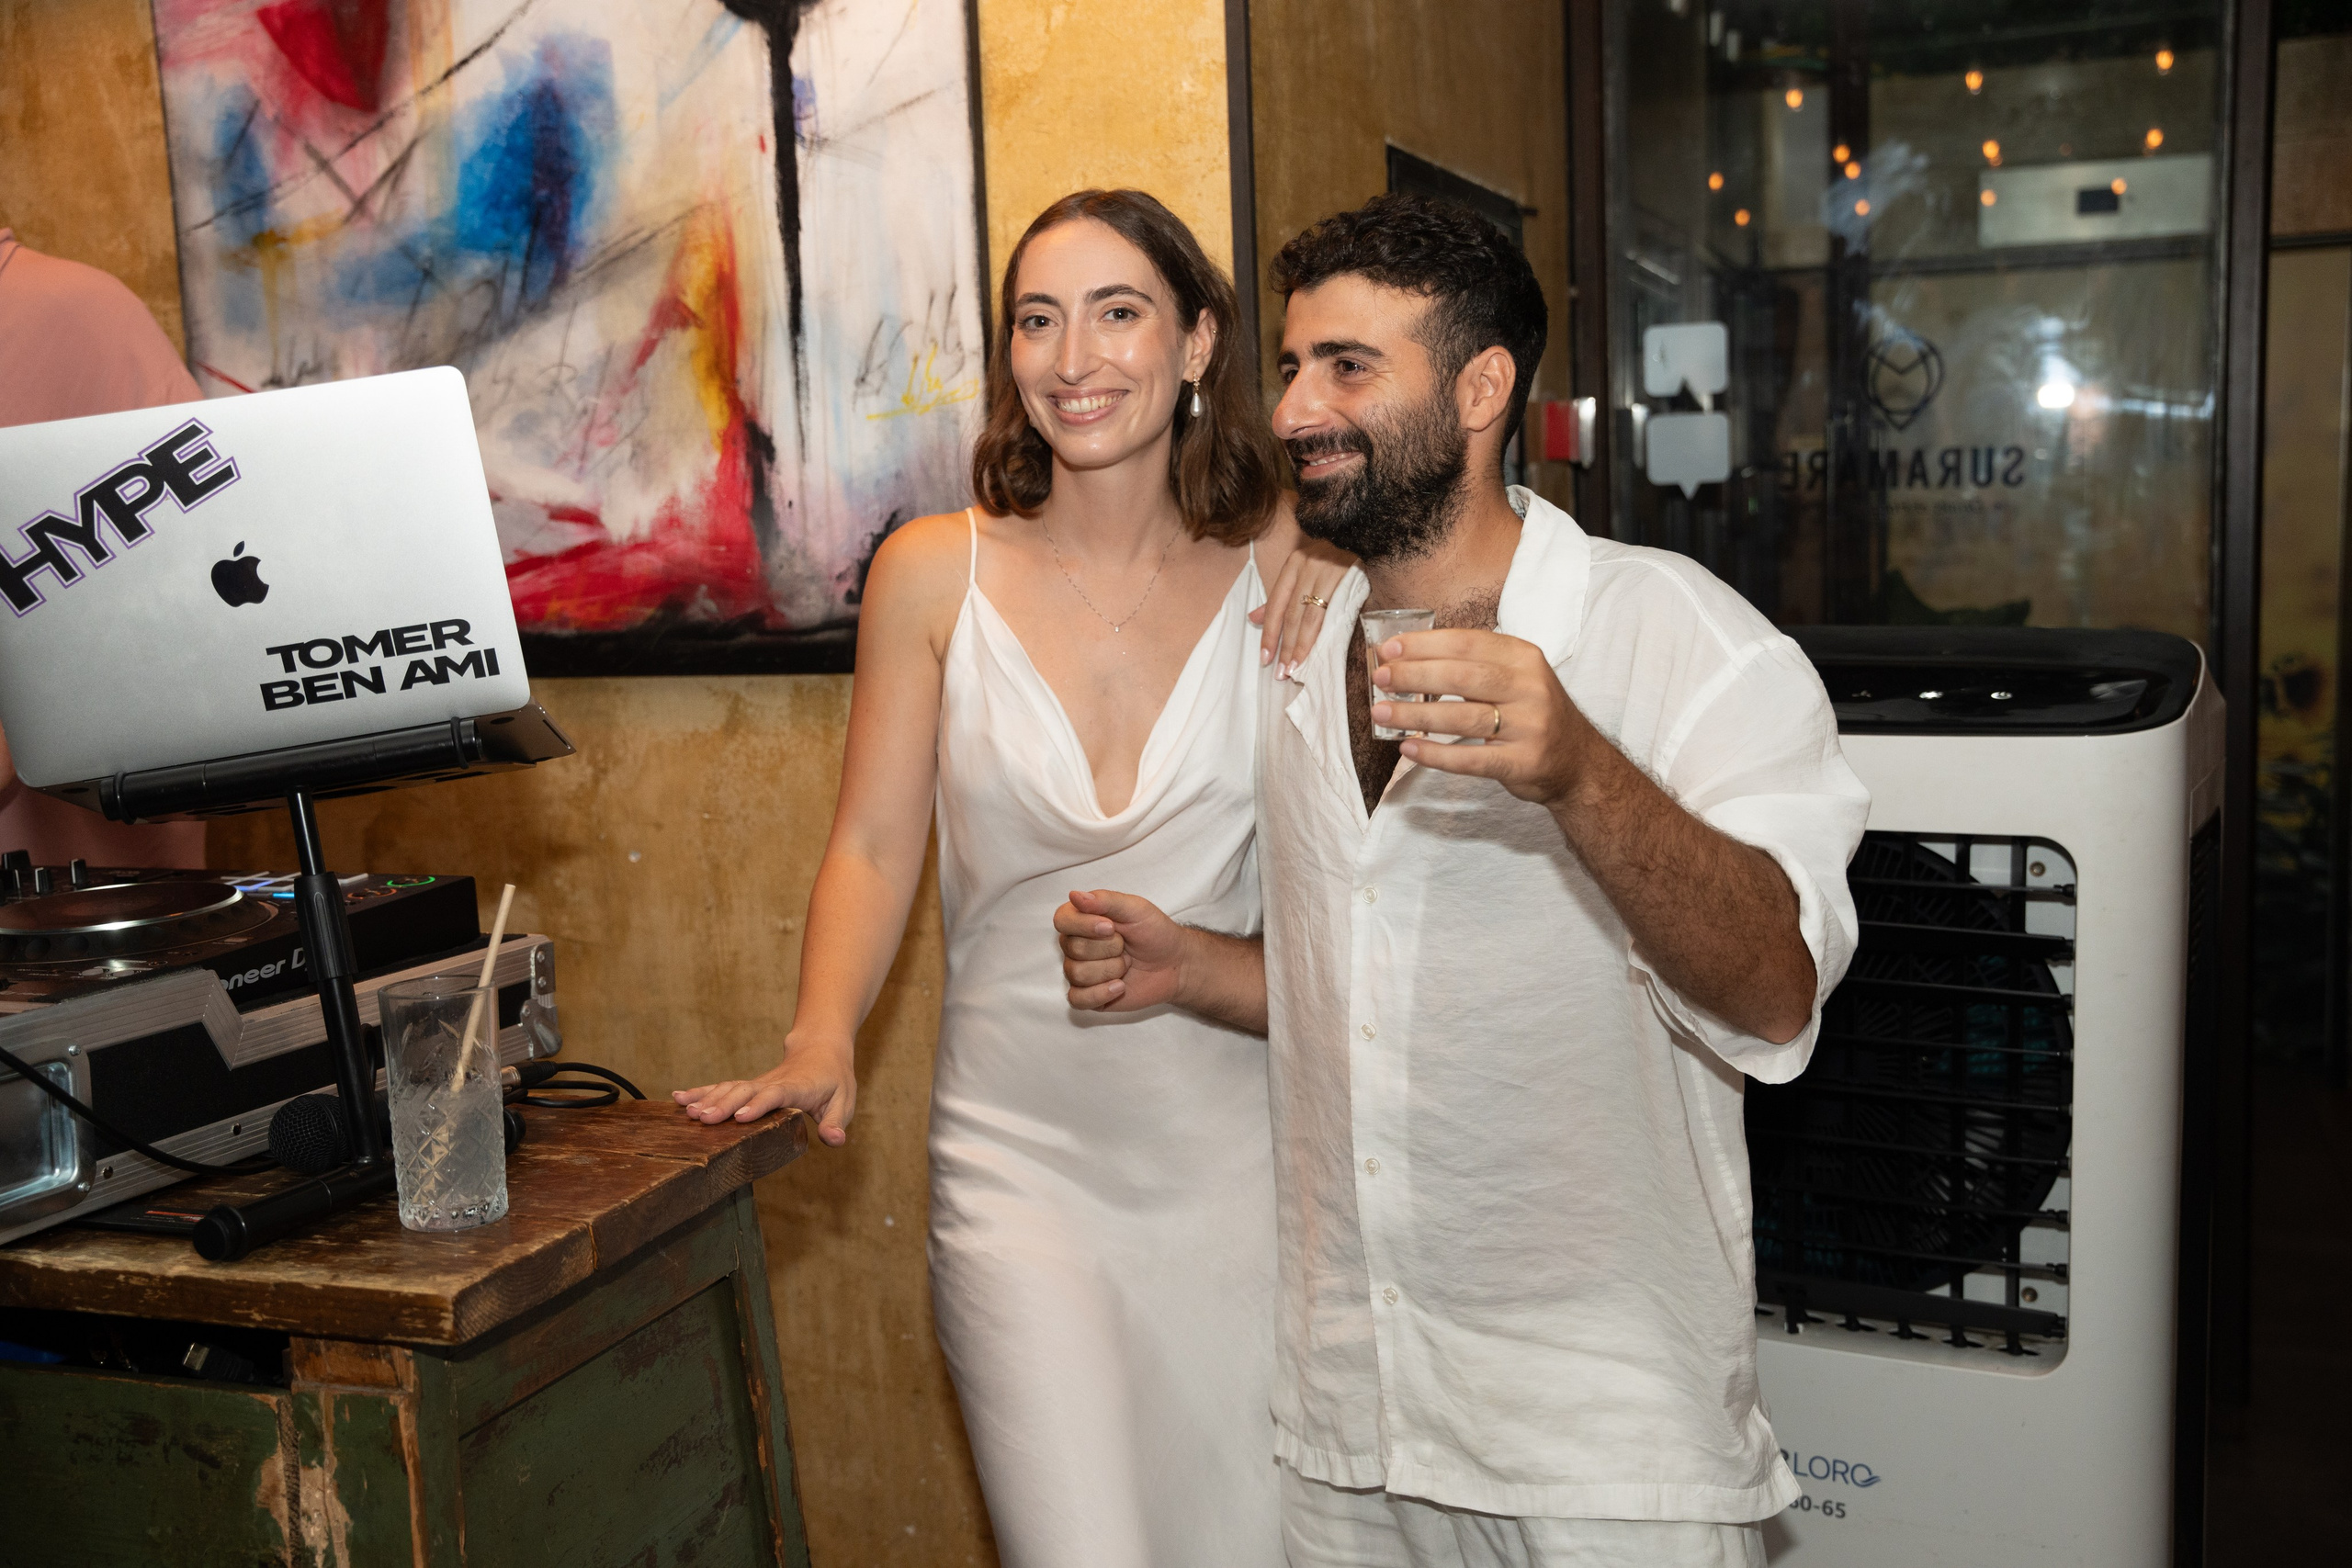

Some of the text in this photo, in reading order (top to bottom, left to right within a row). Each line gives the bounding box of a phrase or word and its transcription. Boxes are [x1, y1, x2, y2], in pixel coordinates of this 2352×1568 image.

[0, 417, 242, 618] HYPE
[266, 618, 474, 674] TOMER
[259, 648, 502, 712] BEN AMI
